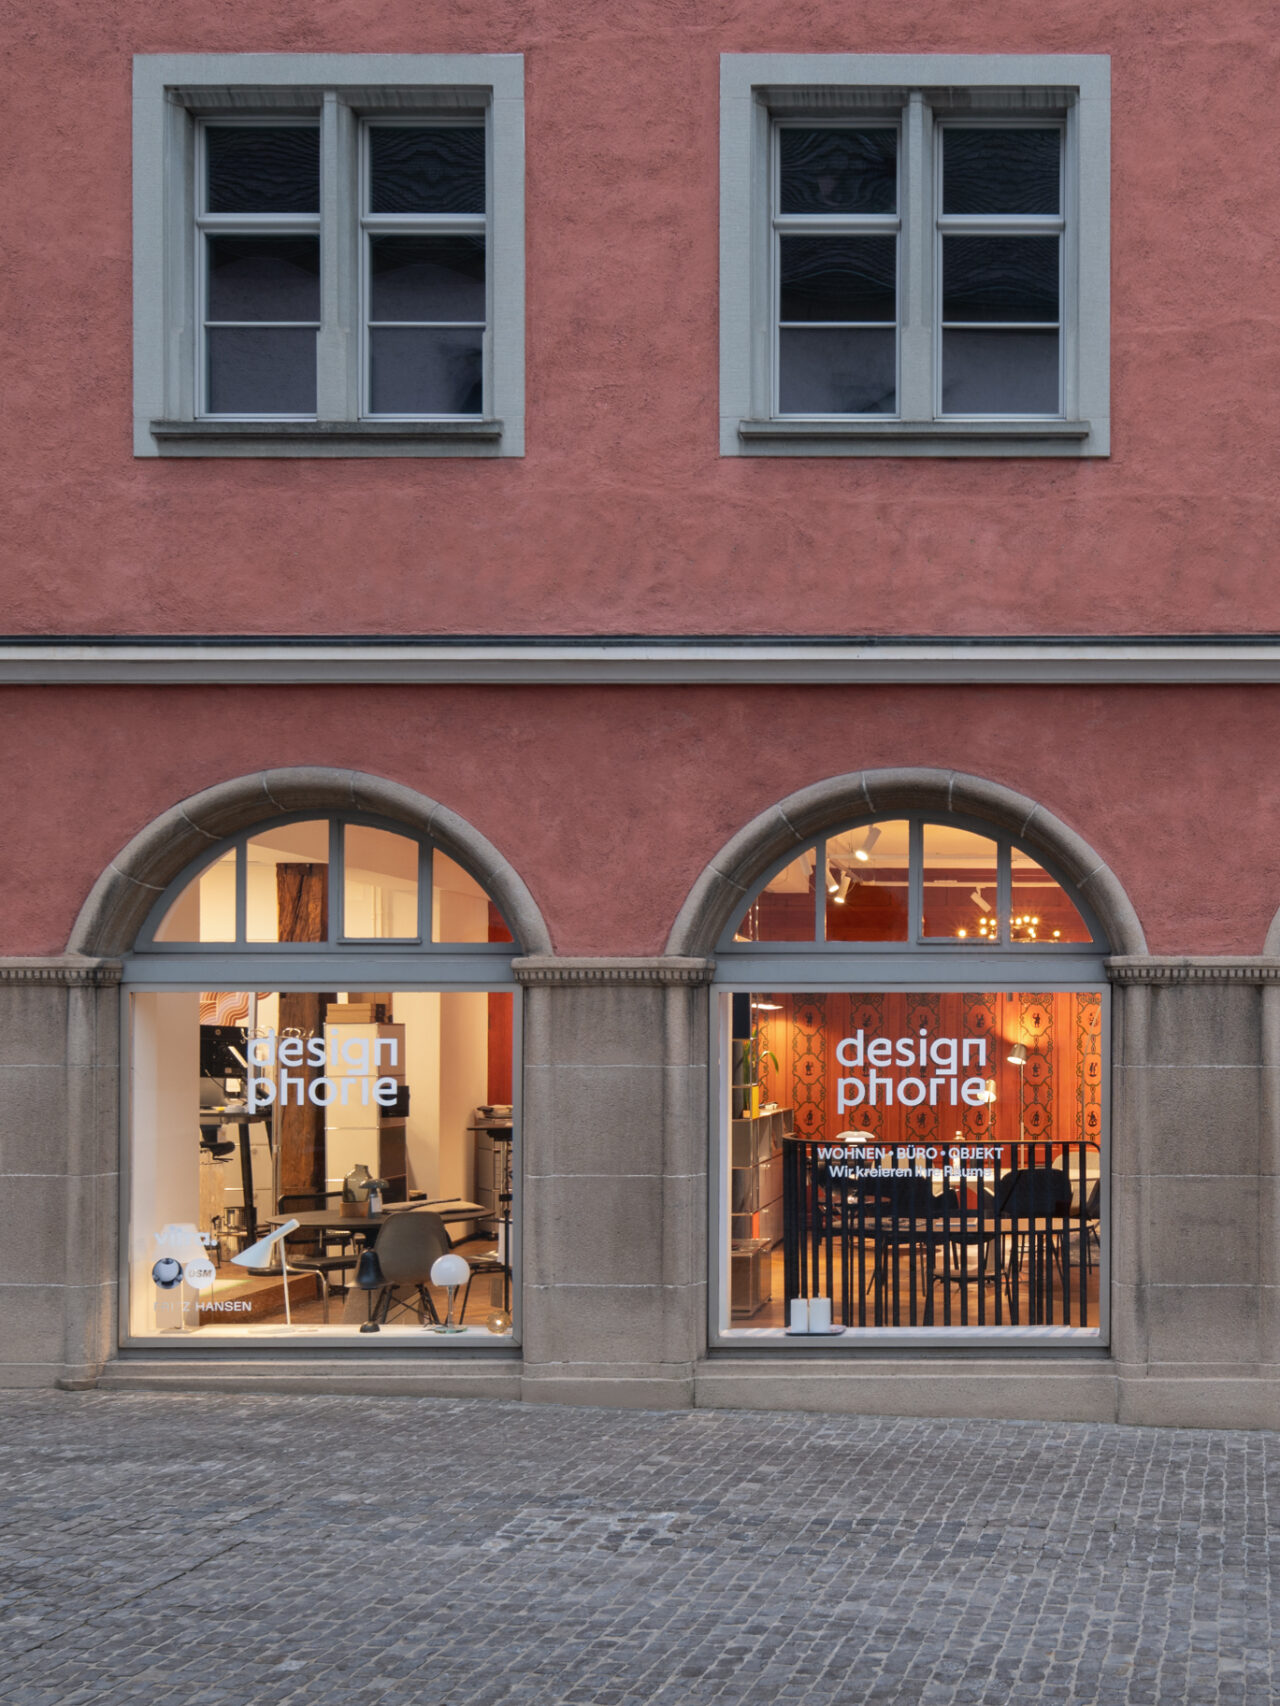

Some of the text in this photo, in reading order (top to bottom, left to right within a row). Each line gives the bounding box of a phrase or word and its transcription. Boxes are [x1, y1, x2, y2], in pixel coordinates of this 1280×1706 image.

[249, 1028, 398, 1075] design
[836, 1028, 987, 1075] design
[249, 1068, 398, 1114] phorie
[837, 1068, 987, 1114] phorie
[817, 1145, 1004, 1160] WOHNEN BÜRO OBJEKT
[829, 1165, 854, 1178] Wir
[856, 1165, 912, 1178] kreieren
[944, 1165, 992, 1178] Rume
[153, 1301, 252, 1312] FRIZ HANSEN
